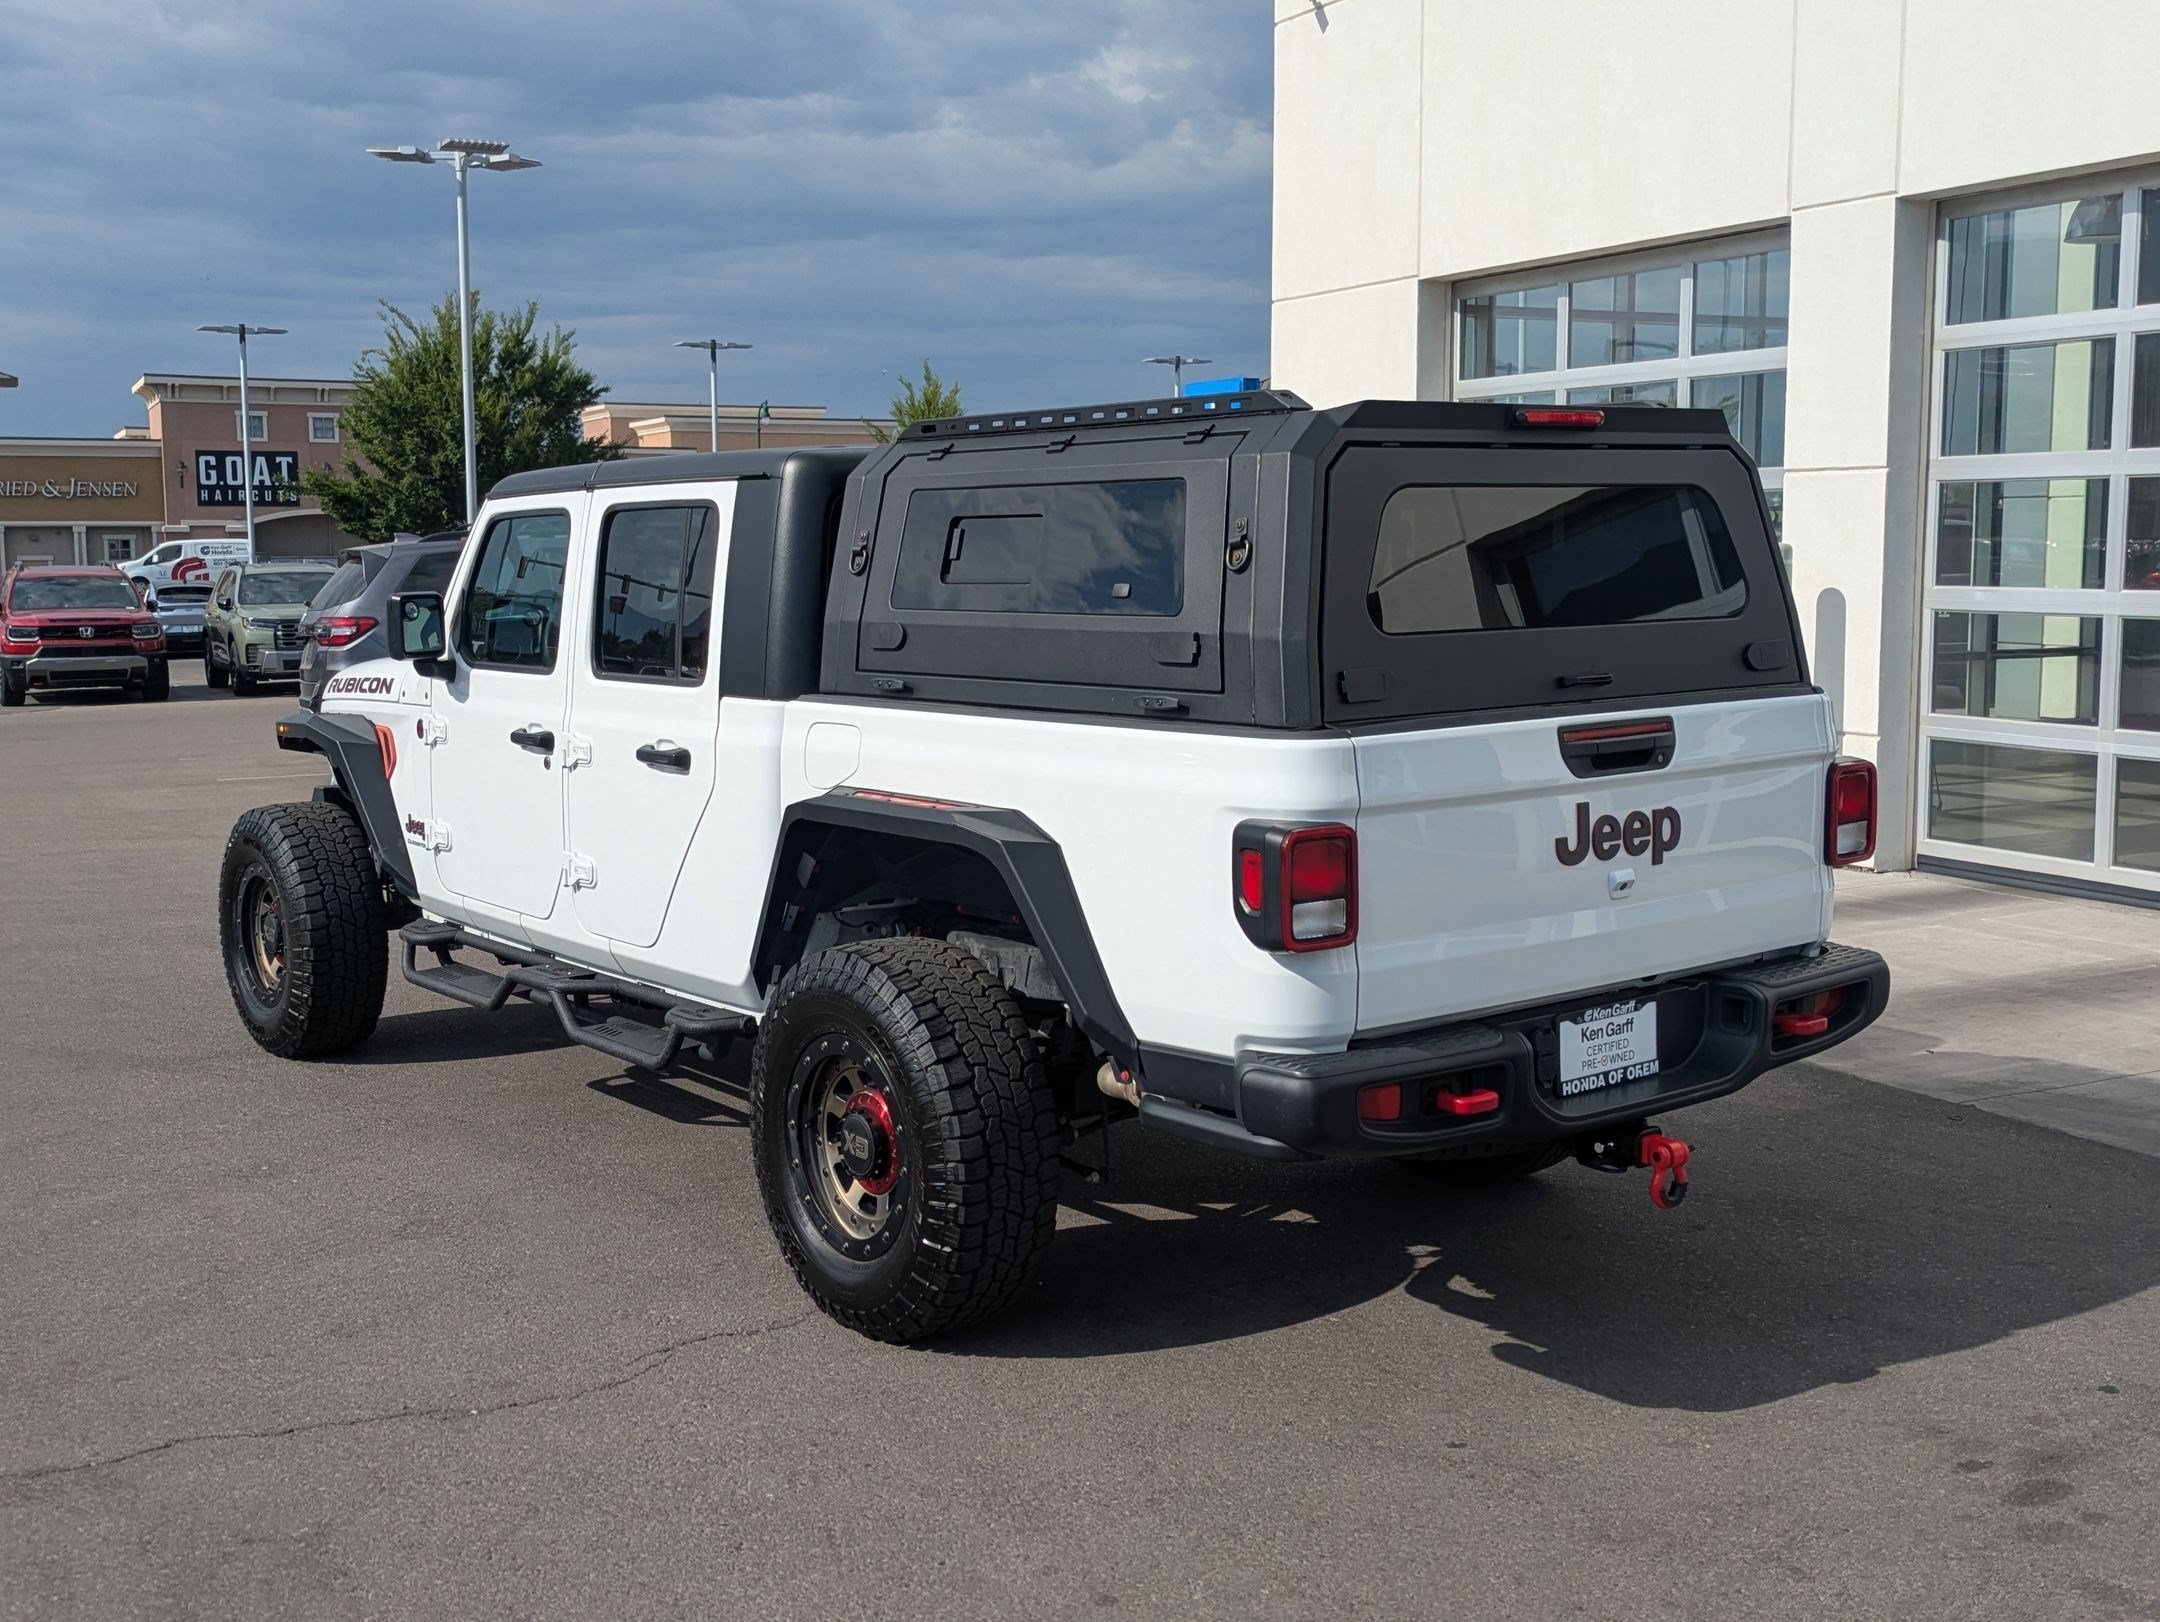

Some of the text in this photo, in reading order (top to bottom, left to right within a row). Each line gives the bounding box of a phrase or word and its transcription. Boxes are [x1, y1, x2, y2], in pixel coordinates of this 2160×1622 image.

[198, 455, 296, 486] G.OA.T.
[41, 478, 62, 497] &
[66, 477, 138, 499] JENSEN
[327, 677, 395, 694] RUBICON
[405, 813, 426, 841] Jeep
[1554, 801, 1682, 867] Jeep
[1592, 1000, 1636, 1021] Ken Garff
[1581, 1017, 1634, 1043] Ken Garff
[1586, 1038, 1629, 1057] CERTIFIED
[1562, 1060, 1660, 1096] HONDA OF OREM
